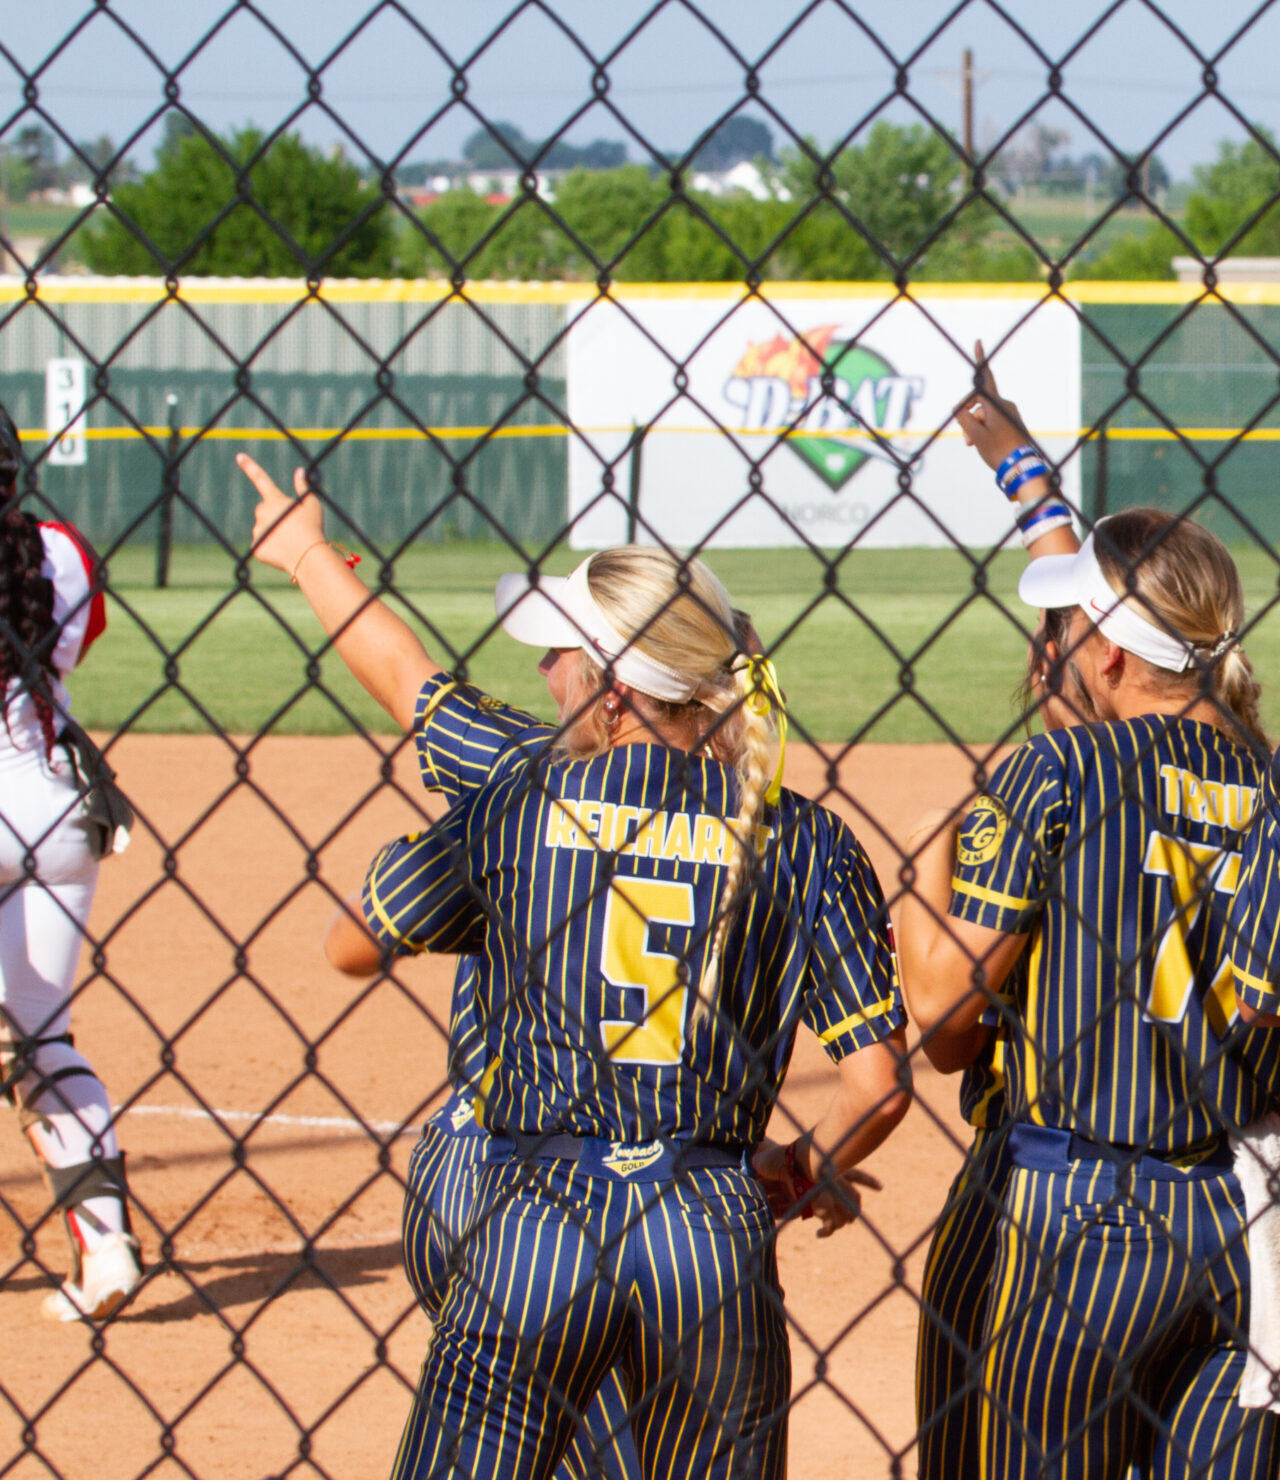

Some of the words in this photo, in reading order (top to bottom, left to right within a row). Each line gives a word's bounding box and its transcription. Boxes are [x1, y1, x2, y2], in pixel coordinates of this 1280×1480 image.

[780, 502, 870, 526] NORCO
[1160, 764, 1259, 834] TROU
[600, 875, 695, 1065] 5
